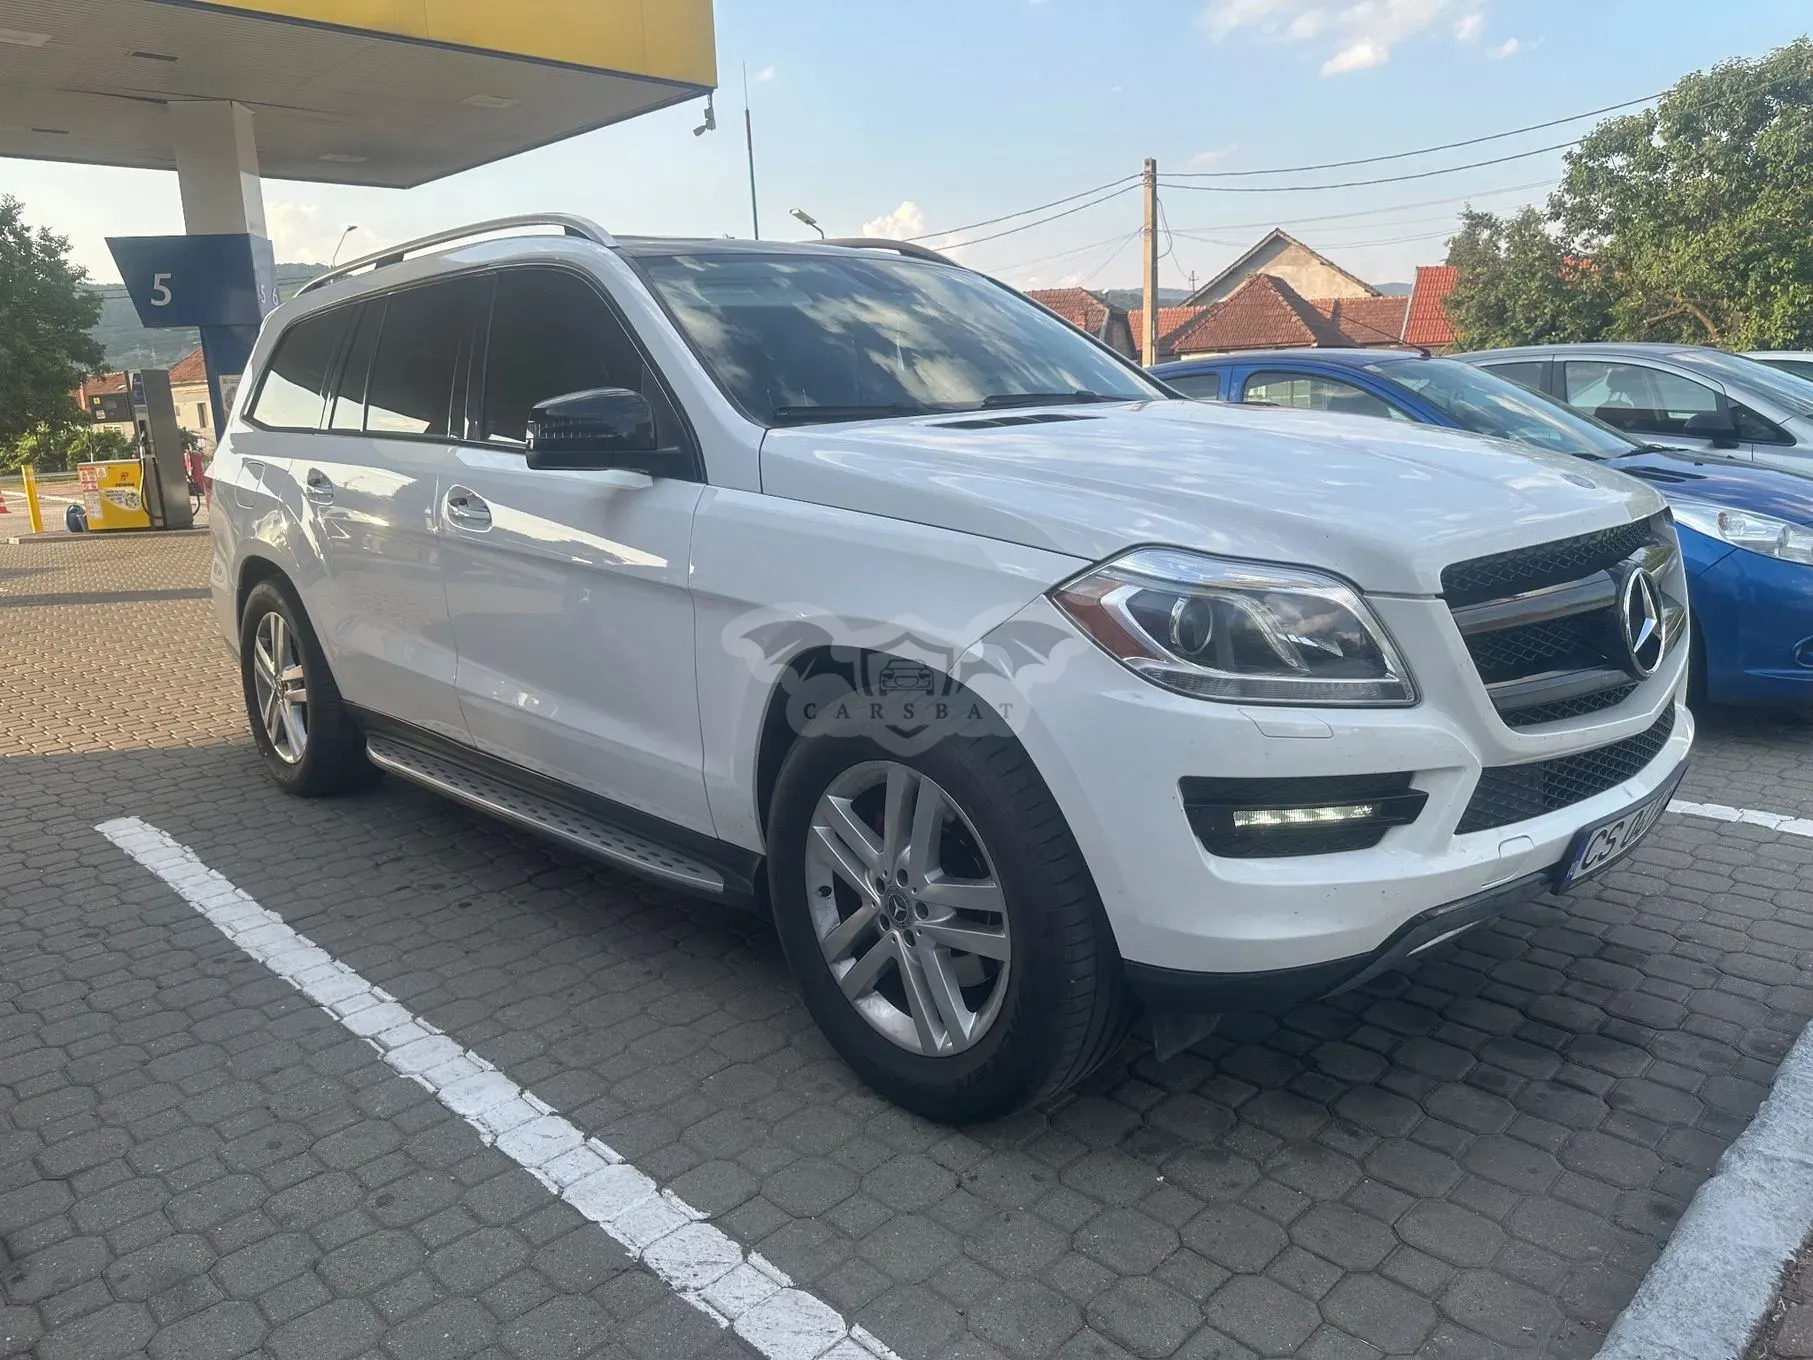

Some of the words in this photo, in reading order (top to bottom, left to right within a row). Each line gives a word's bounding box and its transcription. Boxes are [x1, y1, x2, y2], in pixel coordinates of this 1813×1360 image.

[150, 273, 172, 307] 5
[260, 284, 267, 304] 5
[272, 287, 279, 306] 6
[1581, 820, 1625, 870] CS
